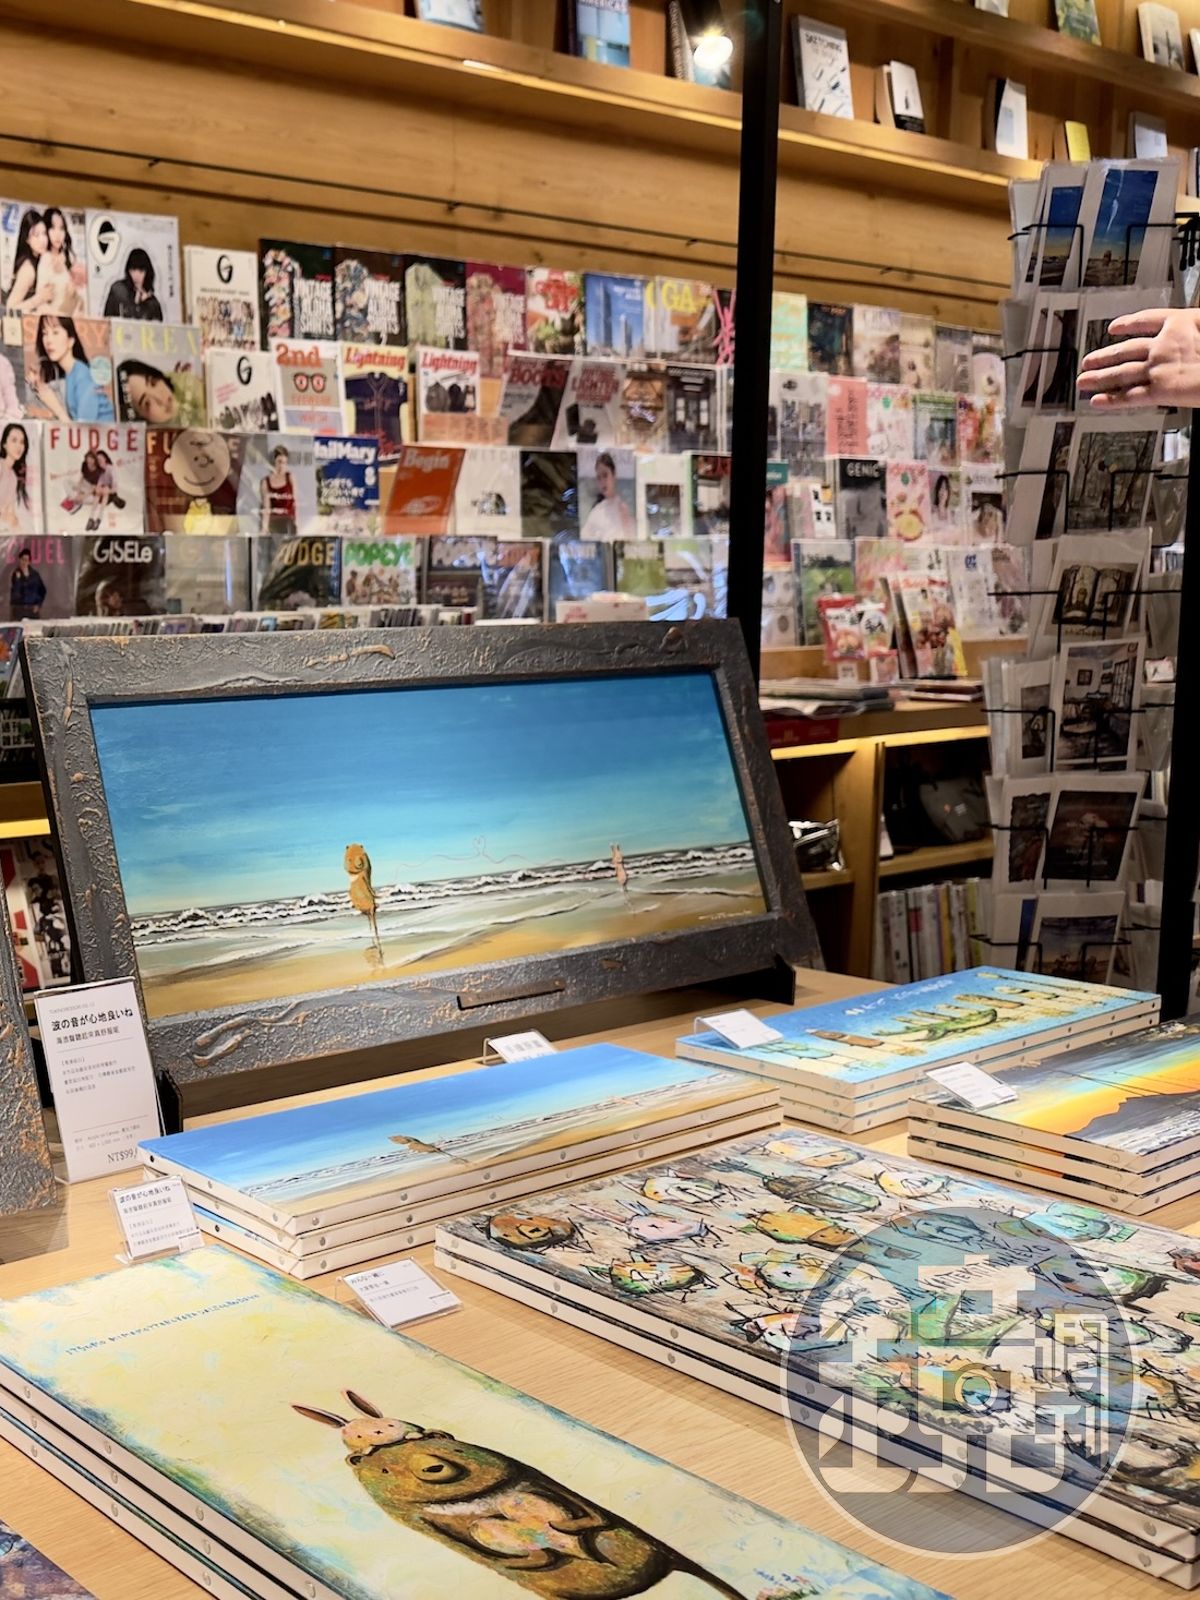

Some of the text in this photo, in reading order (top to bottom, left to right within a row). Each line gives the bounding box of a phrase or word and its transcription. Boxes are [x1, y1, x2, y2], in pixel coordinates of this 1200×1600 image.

[276, 344, 323, 369] 2nd
[345, 346, 406, 371] Lightning
[424, 351, 478, 375] Lightning
[49, 427, 139, 451] FUDGE
